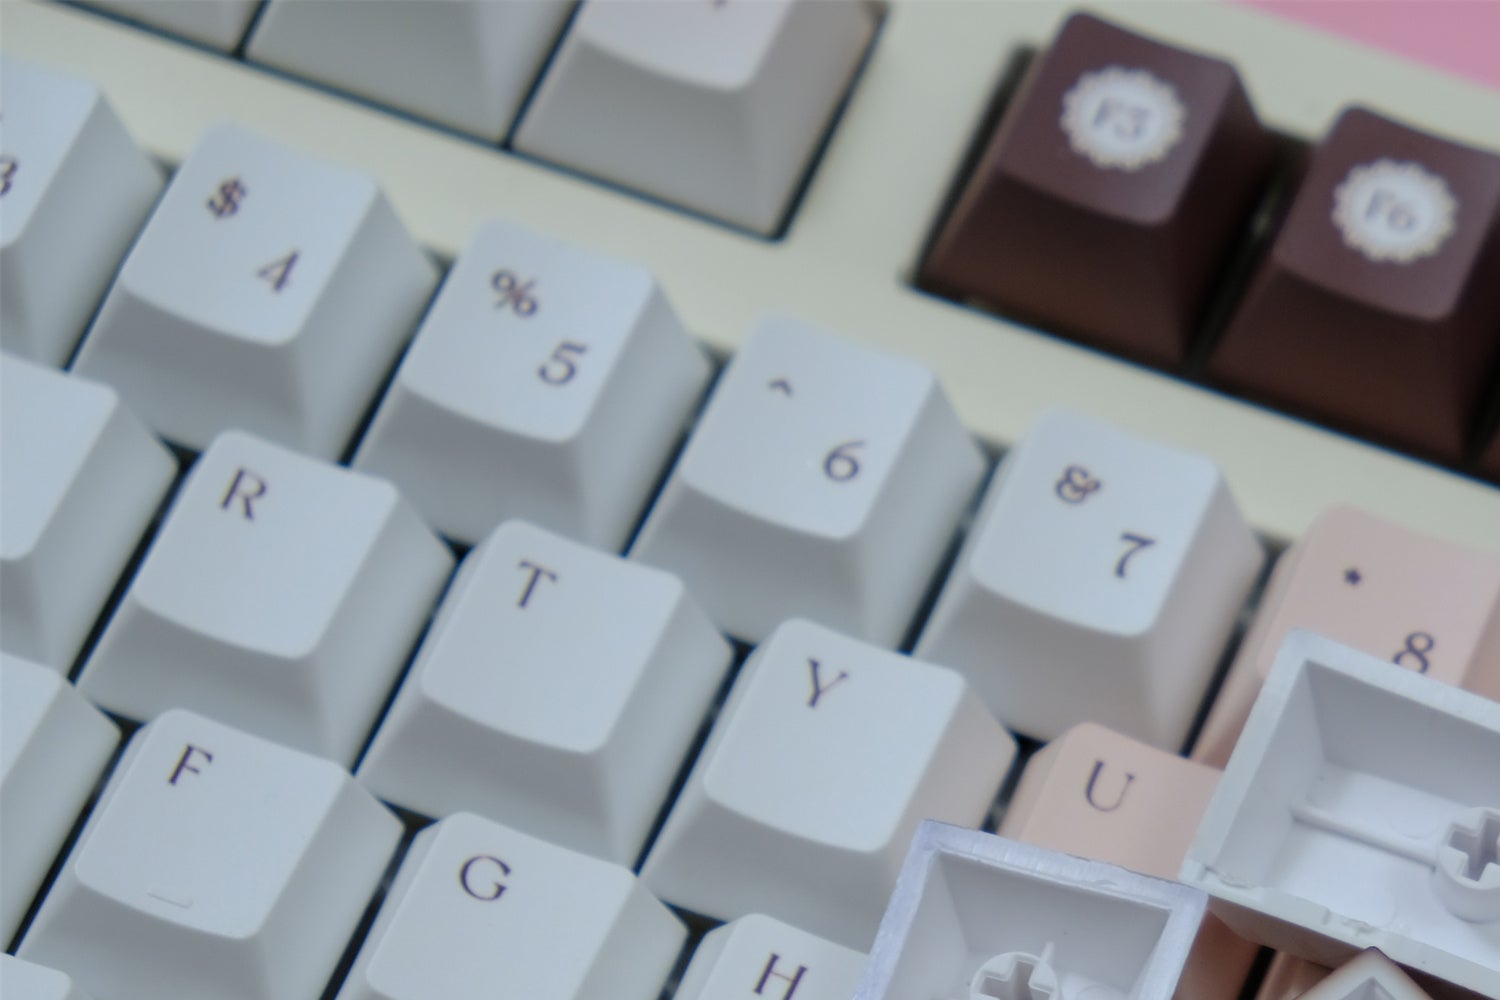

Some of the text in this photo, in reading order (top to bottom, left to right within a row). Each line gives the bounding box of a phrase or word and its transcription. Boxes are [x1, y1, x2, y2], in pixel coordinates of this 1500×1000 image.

[206, 177, 248, 220] $
[255, 249, 301, 293] 4
[491, 270, 538, 317] %
[538, 341, 587, 386] 5
[822, 440, 865, 483] 6
[221, 469, 266, 520] R
[1054, 466, 1102, 504] &
[1115, 533, 1155, 578] 7
[518, 561, 556, 608] T
[1393, 631, 1435, 674] 8
[808, 659, 847, 708] Y
[169, 745, 212, 785] F
[1084, 760, 1136, 813] U
[459, 857, 510, 900] G
